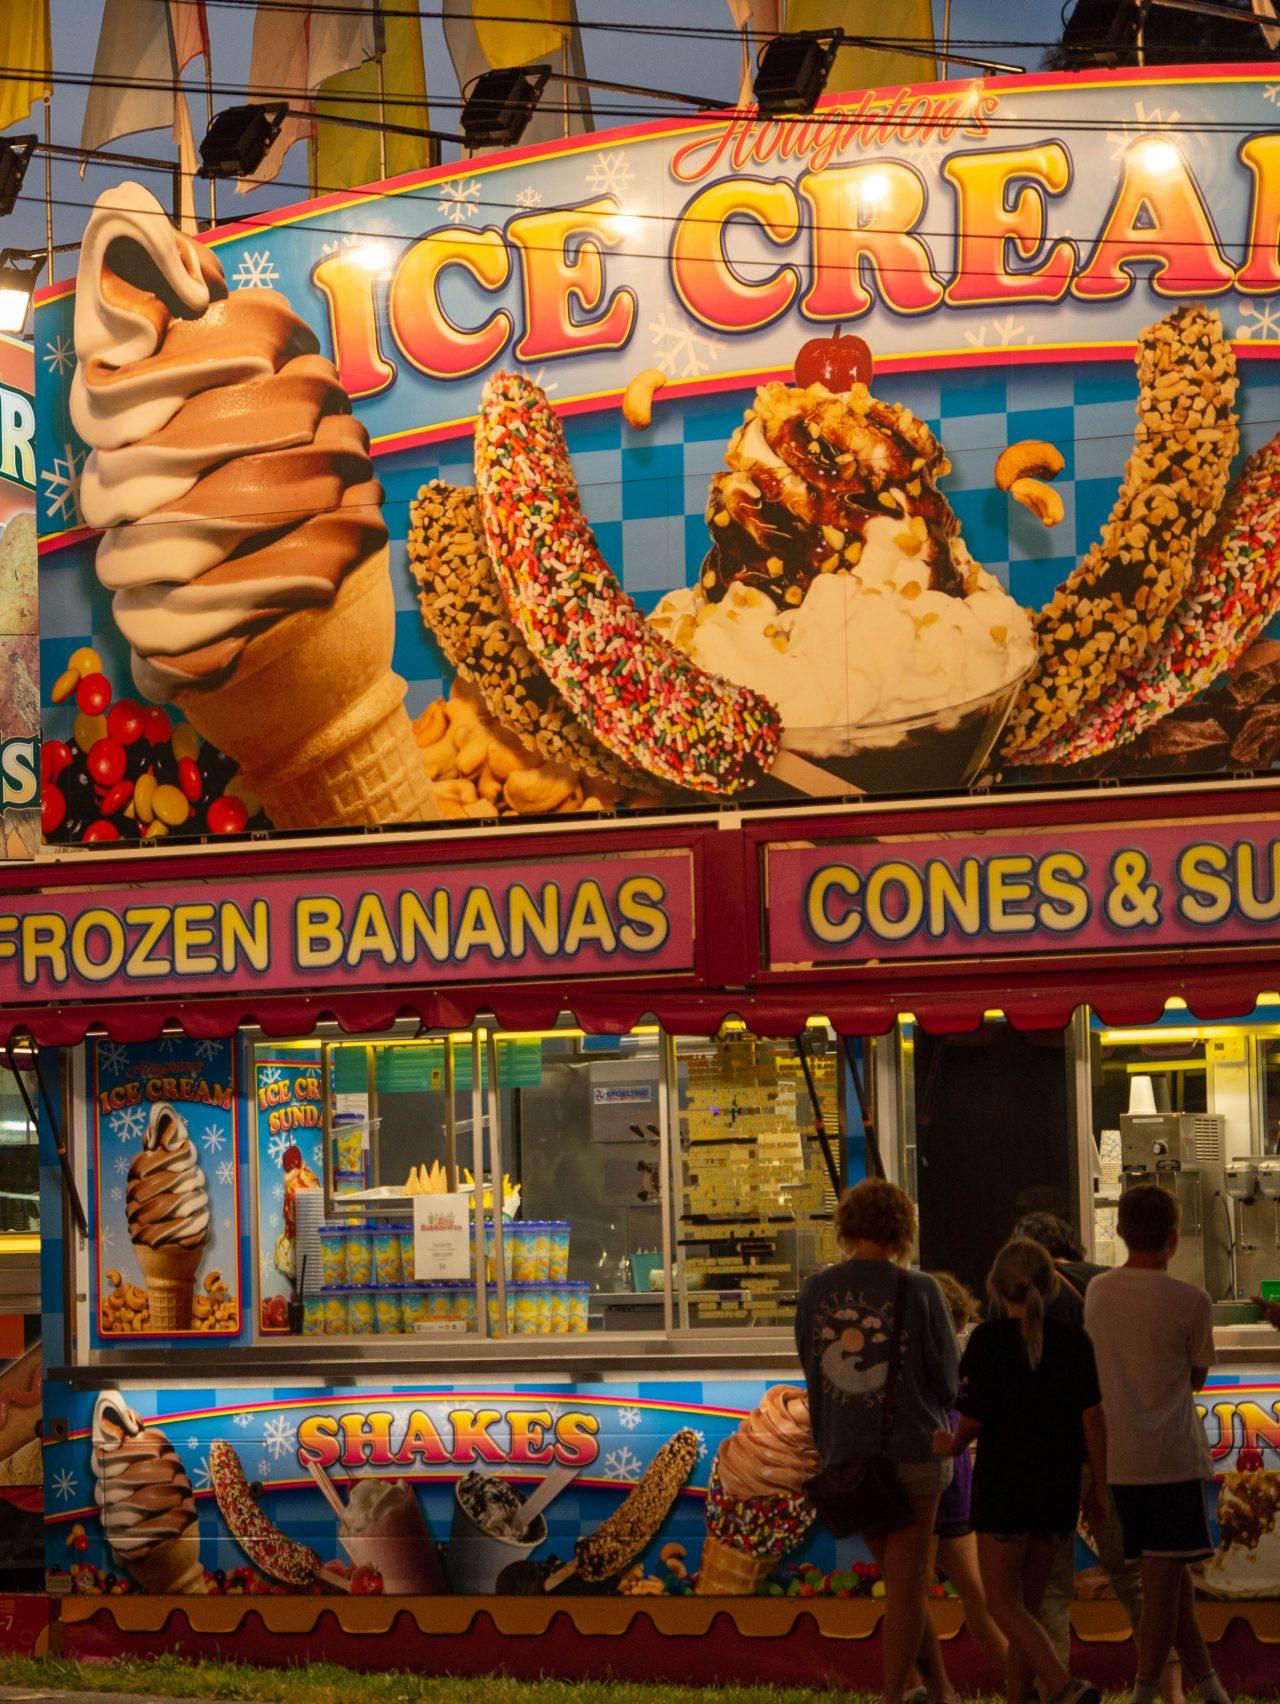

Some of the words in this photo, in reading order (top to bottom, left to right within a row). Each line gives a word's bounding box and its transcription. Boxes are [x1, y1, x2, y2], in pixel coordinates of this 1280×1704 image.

[671, 84, 1000, 183] Houghton's
[312, 195, 639, 402] ICE
[295, 876, 667, 970] BANANAS
[807, 850, 1088, 943] CONES
[1107, 849, 1161, 929] &
[1179, 841, 1280, 923] SU
[99, 1081, 142, 1114] ICE
[146, 1077, 233, 1110] CREAM
[258, 1080, 291, 1110] ICE
[294, 1077, 322, 1100] CR
[297, 1410, 599, 1468] SHAKES
[1195, 1401, 1280, 1461] UN
